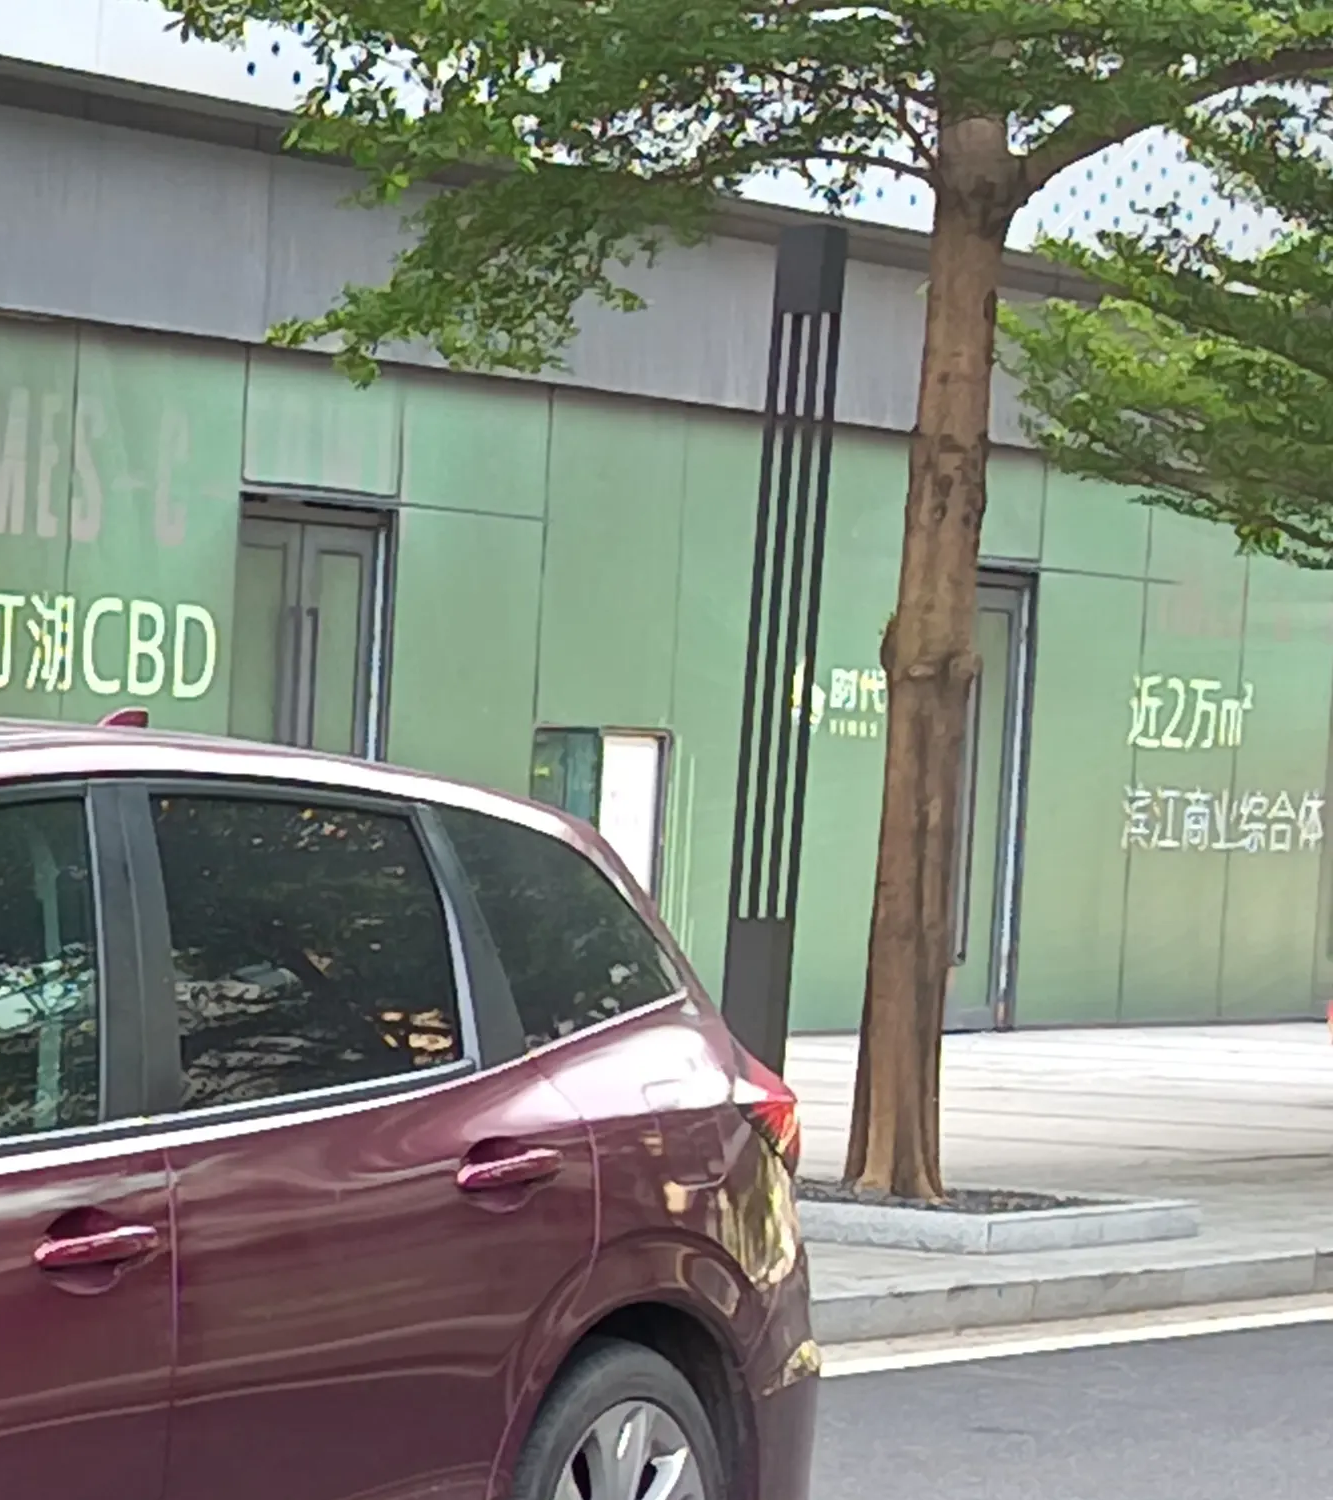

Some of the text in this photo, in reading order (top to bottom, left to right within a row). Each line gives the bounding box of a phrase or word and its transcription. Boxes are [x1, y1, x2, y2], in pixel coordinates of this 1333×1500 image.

[1126, 671, 1255, 752] 近2万m²
[1121, 782, 1327, 854] 滨江商业综合体
